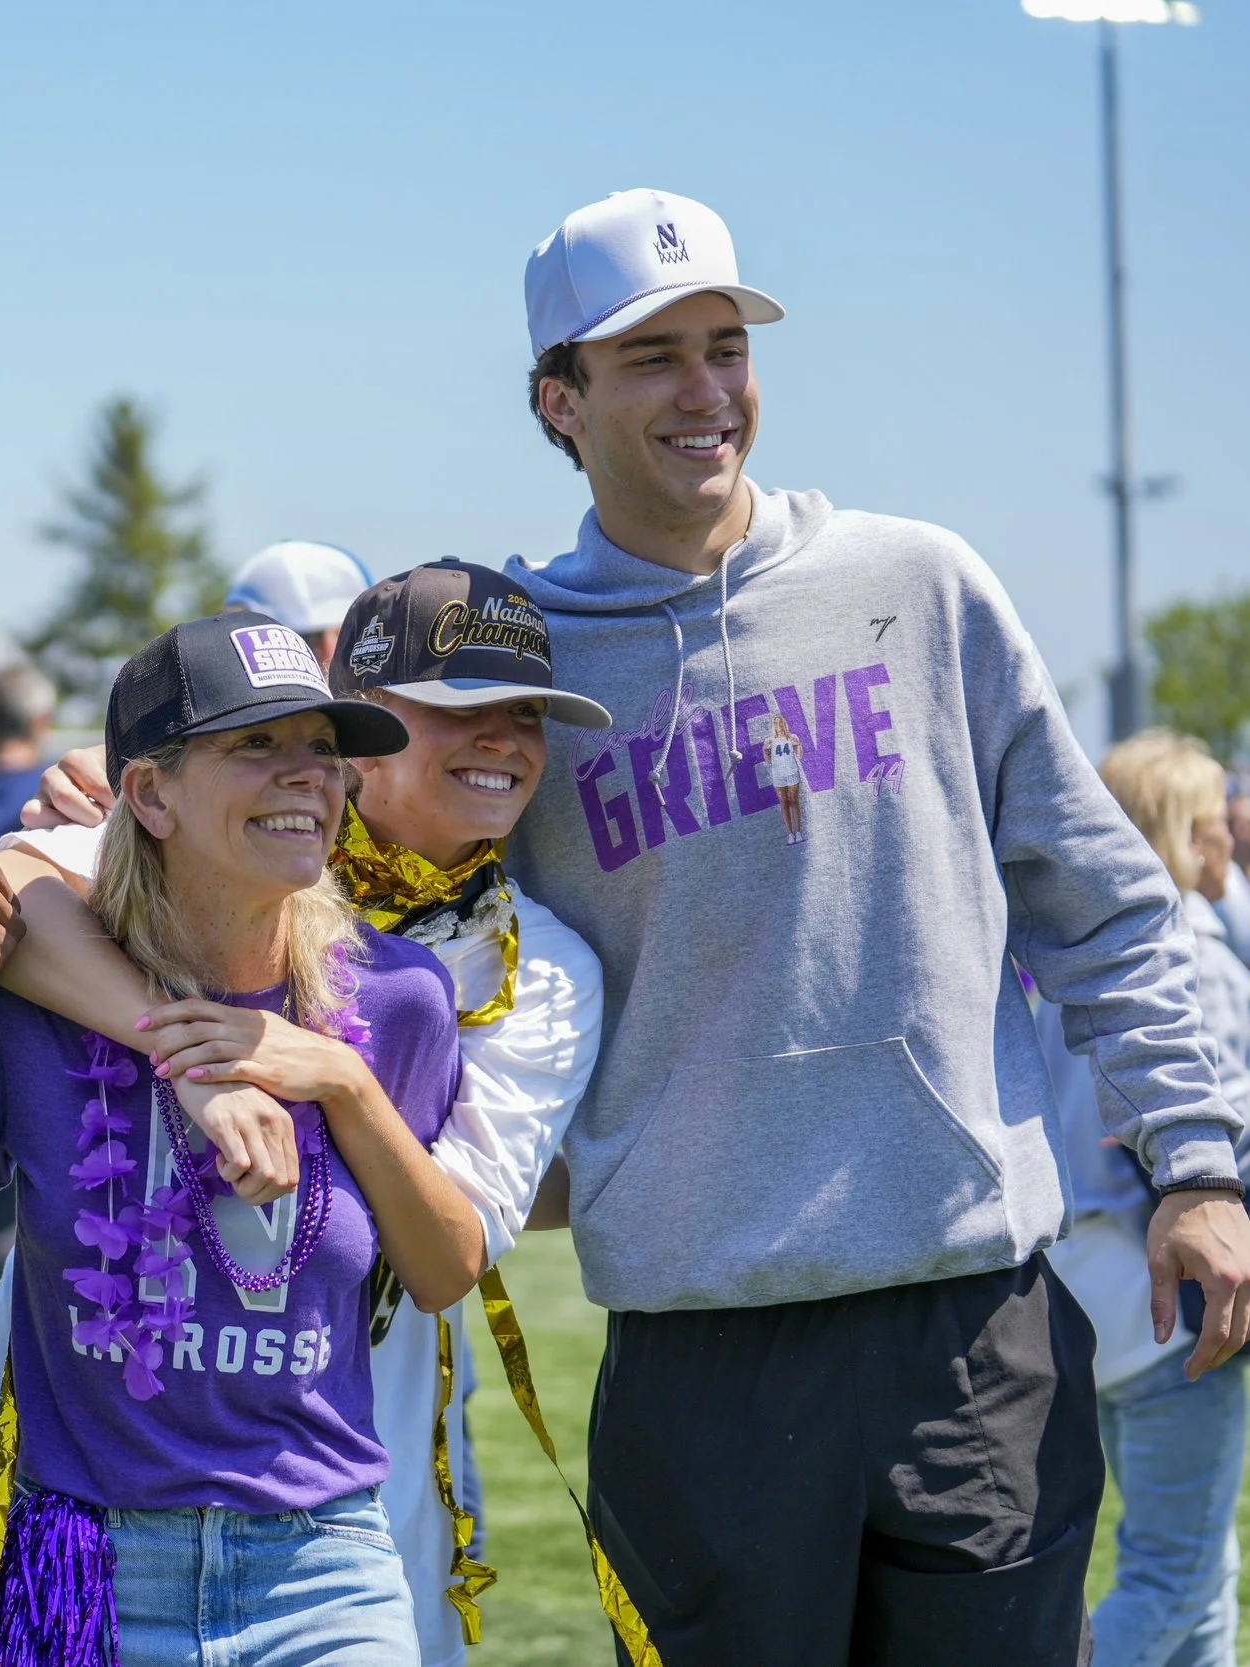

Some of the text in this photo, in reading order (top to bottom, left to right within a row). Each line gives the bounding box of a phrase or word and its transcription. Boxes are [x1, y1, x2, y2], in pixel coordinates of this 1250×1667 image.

[656, 223, 678, 249] N
[482, 596, 547, 636] National
[576, 662, 901, 872] GRIEVE
[775, 743, 790, 756] 44
[865, 759, 905, 797] 44
[68, 1304, 332, 1376] LROSSE
